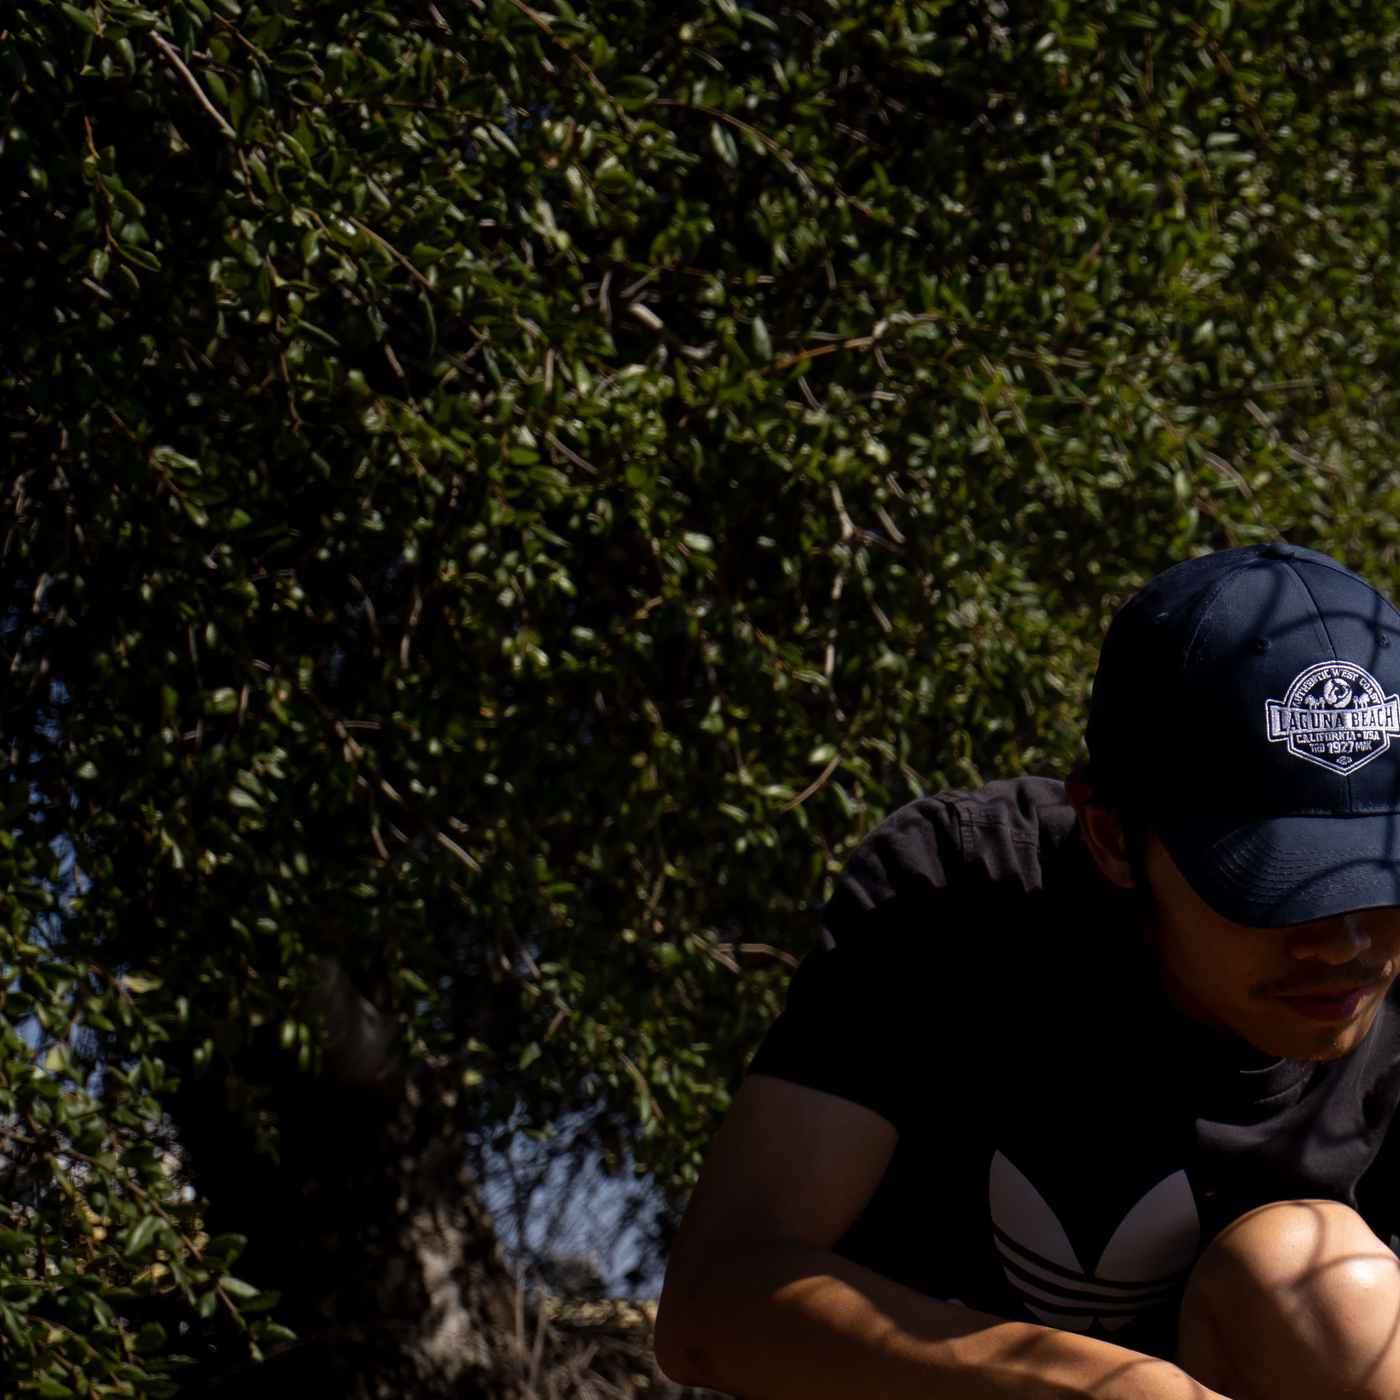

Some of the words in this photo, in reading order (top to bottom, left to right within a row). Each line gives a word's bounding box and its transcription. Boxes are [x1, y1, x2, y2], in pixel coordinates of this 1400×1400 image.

[1292, 668, 1331, 707] AUTHENTIC
[1330, 668, 1359, 681] WEST
[1359, 678, 1381, 704] COAST
[1278, 709, 1345, 733] LAGUNA
[1351, 706, 1394, 727] BEACH
[1296, 731, 1356, 743] CALIFORNIA
[1363, 731, 1381, 741] USA
[1326, 741, 1354, 754] 1927
